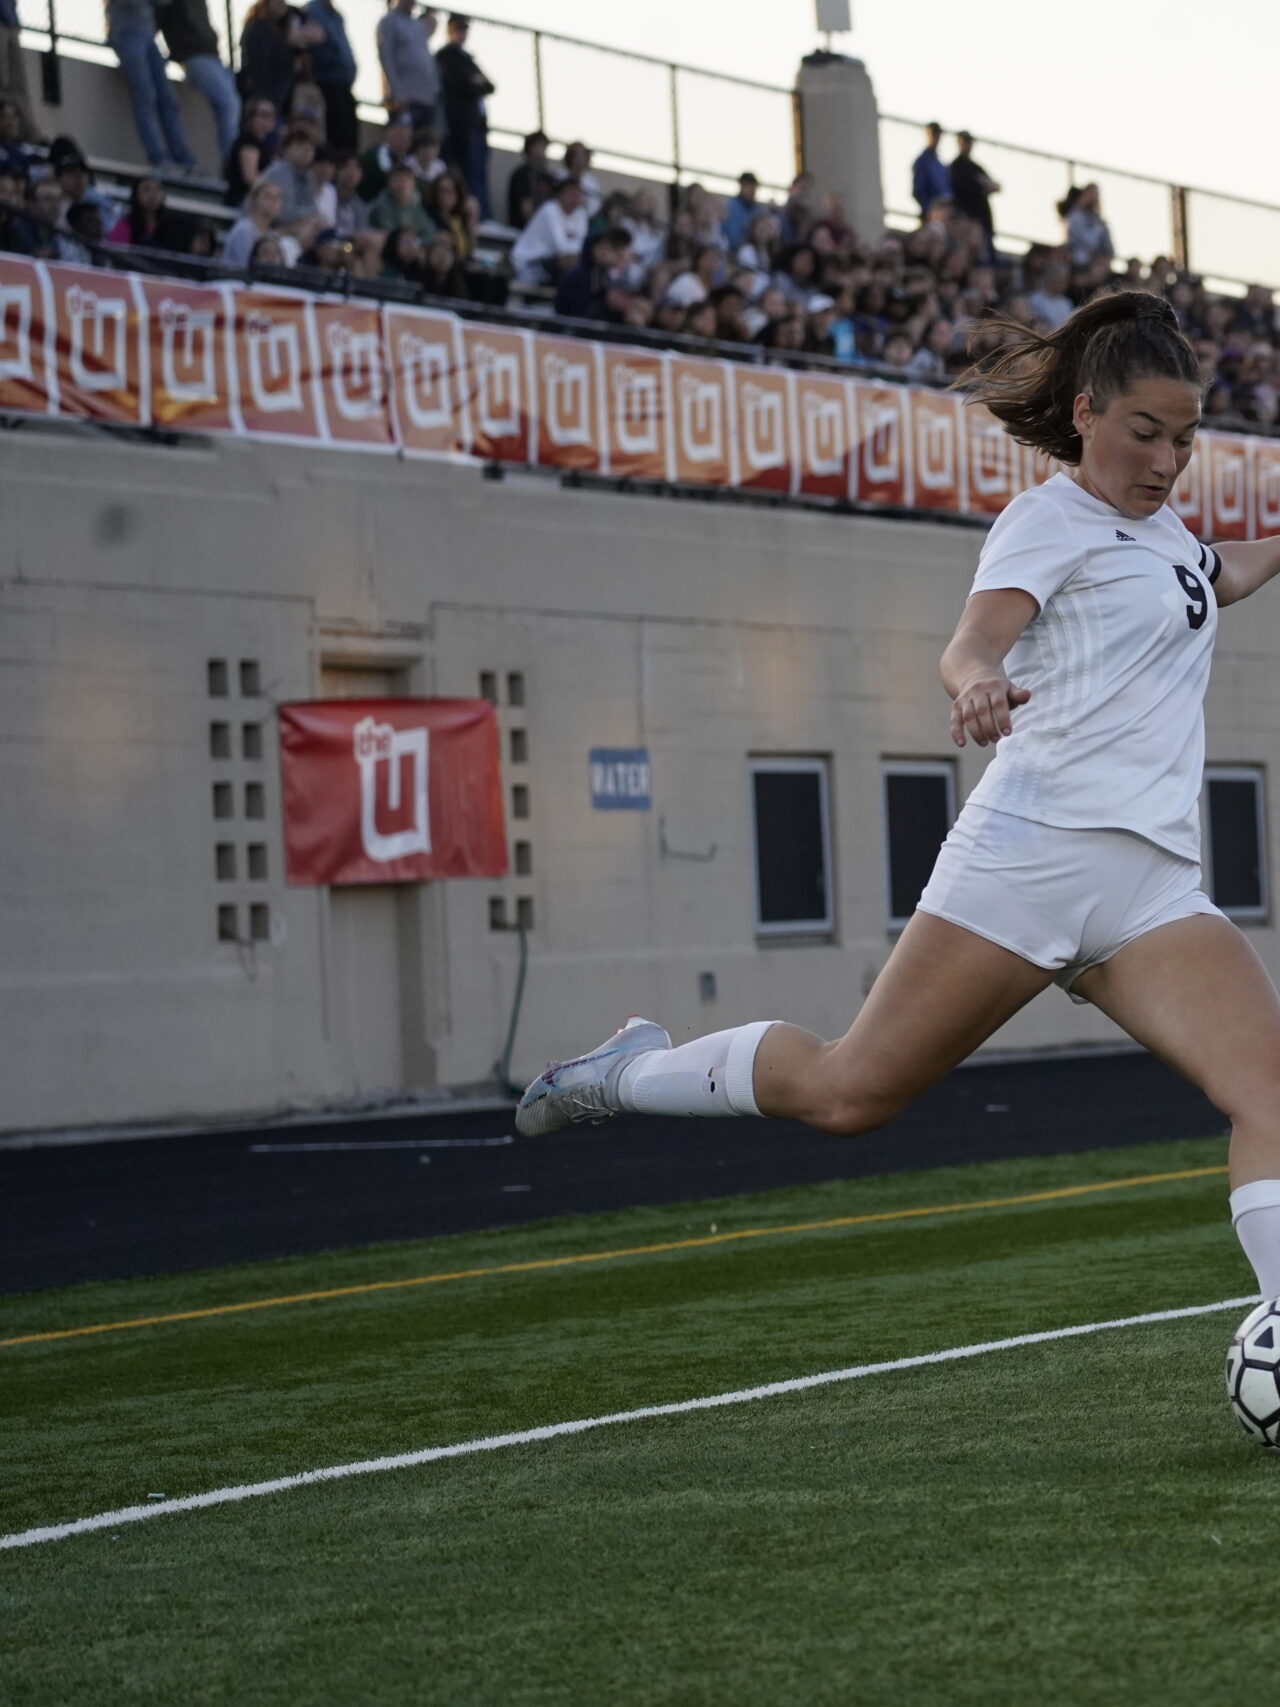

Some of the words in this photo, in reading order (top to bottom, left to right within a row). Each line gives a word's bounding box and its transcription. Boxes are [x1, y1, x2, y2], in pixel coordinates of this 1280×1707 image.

[1172, 565, 1208, 630] 9
[356, 724, 392, 758] the
[591, 761, 650, 797] WATER
